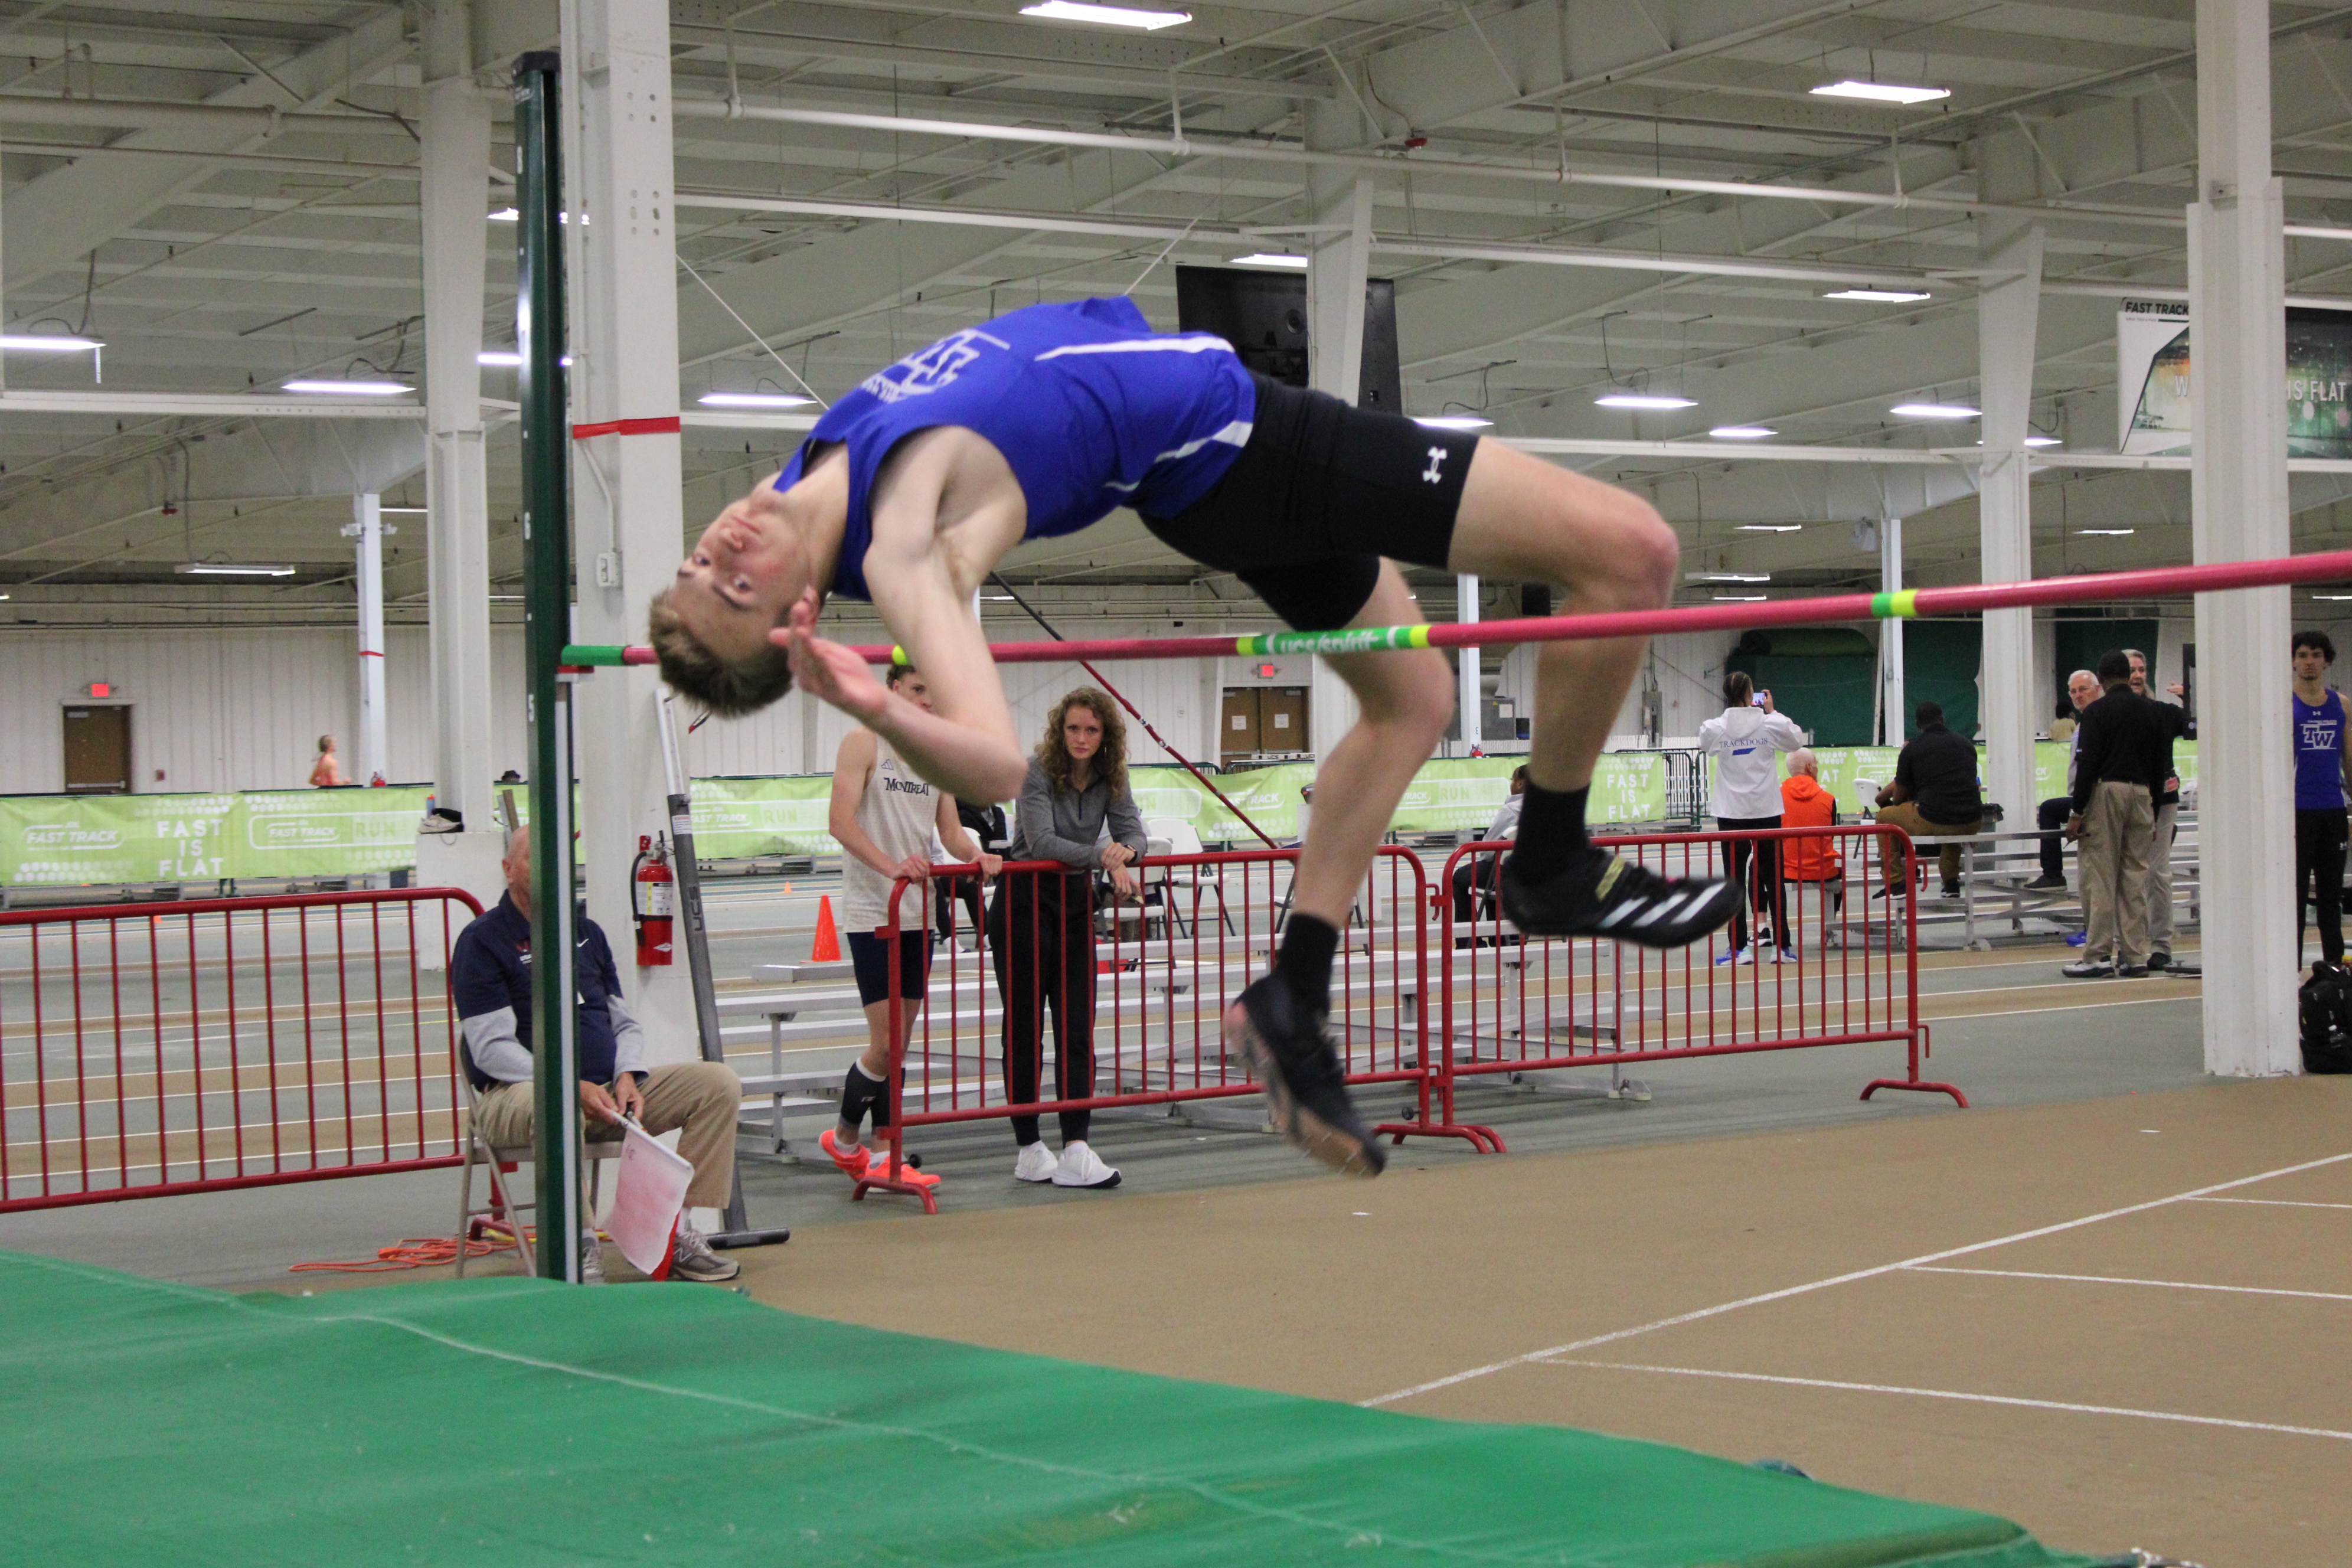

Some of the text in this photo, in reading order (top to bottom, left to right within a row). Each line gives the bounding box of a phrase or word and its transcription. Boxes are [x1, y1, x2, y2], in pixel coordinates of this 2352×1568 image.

[2126, 302, 2189, 315] FAST TRACK
[2288, 380, 2347, 402] IS FLAT
[1719, 737, 1768, 748] TRACKDOGS
[2303, 726, 2335, 749] TW
[1606, 773, 1649, 788] FAST
[1440, 787, 1469, 801] RUN
[1621, 789, 1636, 803] IS
[716, 814, 747, 822] TRACK
[763, 808, 797, 824] RUN
[1608, 804, 1651, 819] FLAT
[156, 818, 223, 838] FAST
[269, 827, 337, 837] FAST TRACK
[355, 821, 395, 837] RUN
[27, 830, 119, 844] FAST TRACK
[179, 839, 204, 857] IS
[158, 857, 224, 877] FLAT
[688, 886, 703, 931] UCS
